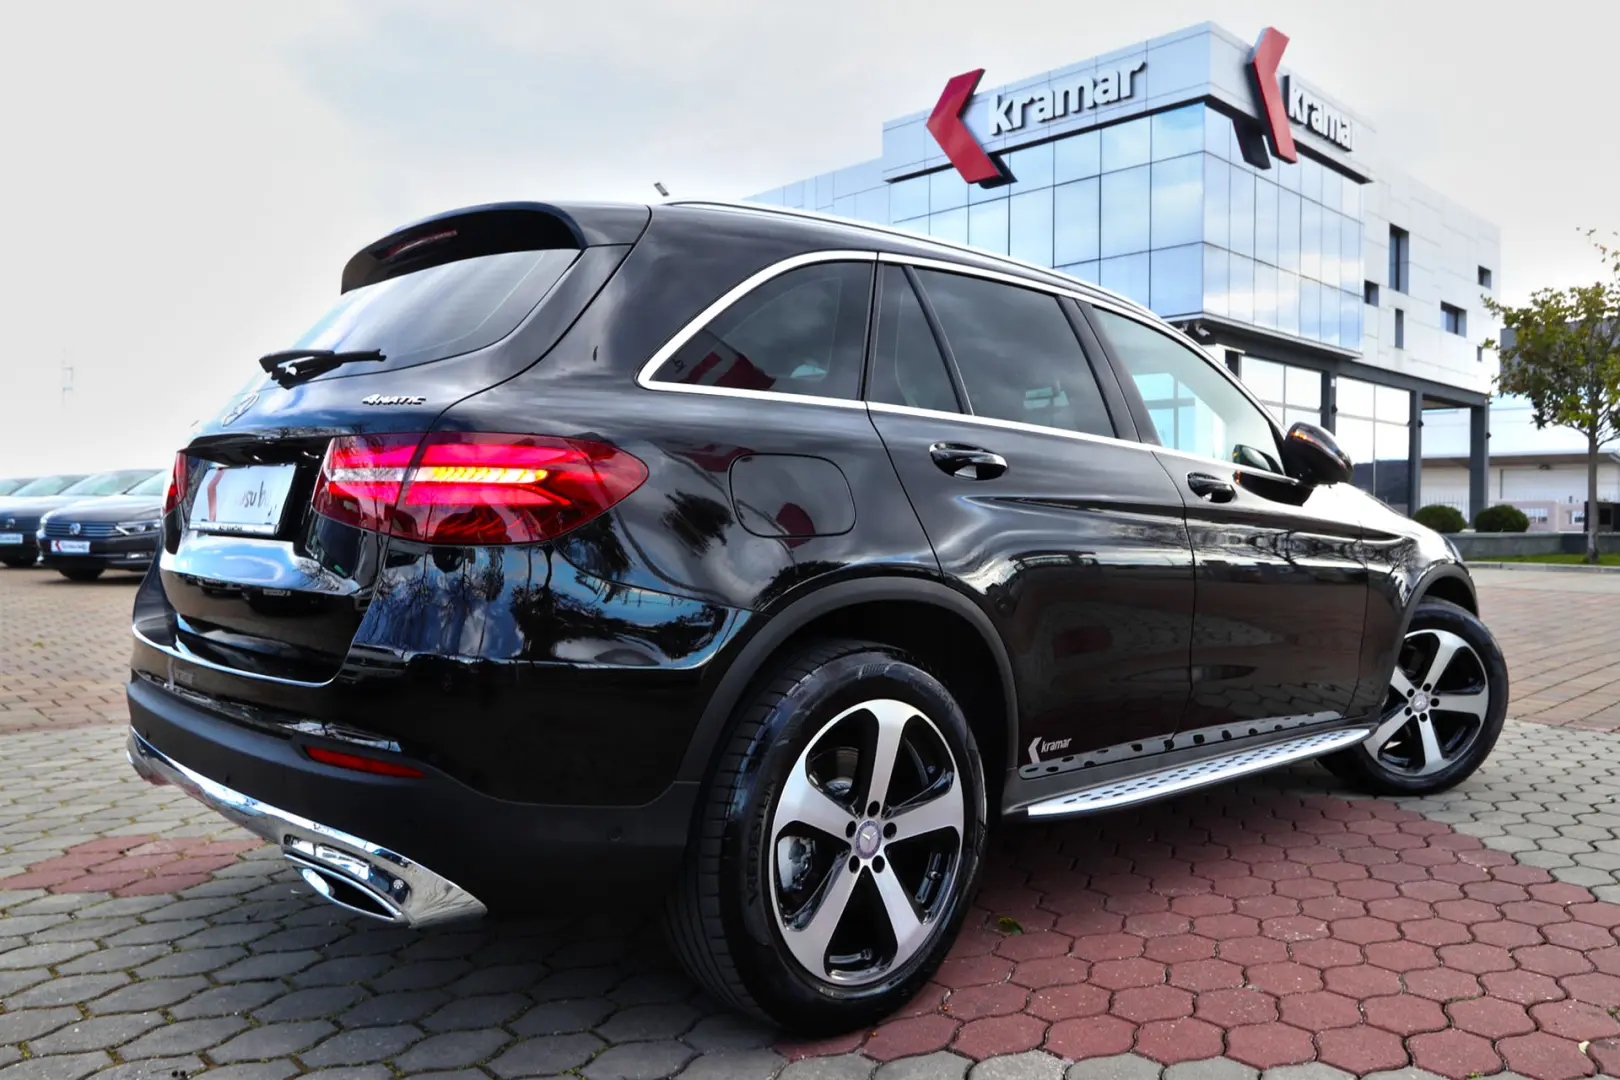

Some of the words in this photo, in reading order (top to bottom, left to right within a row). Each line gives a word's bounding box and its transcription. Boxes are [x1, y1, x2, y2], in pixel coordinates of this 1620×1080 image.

[989, 60, 1146, 135] kramar
[362, 393, 427, 406] 4MATIC
[1041, 738, 1072, 753] kramar
